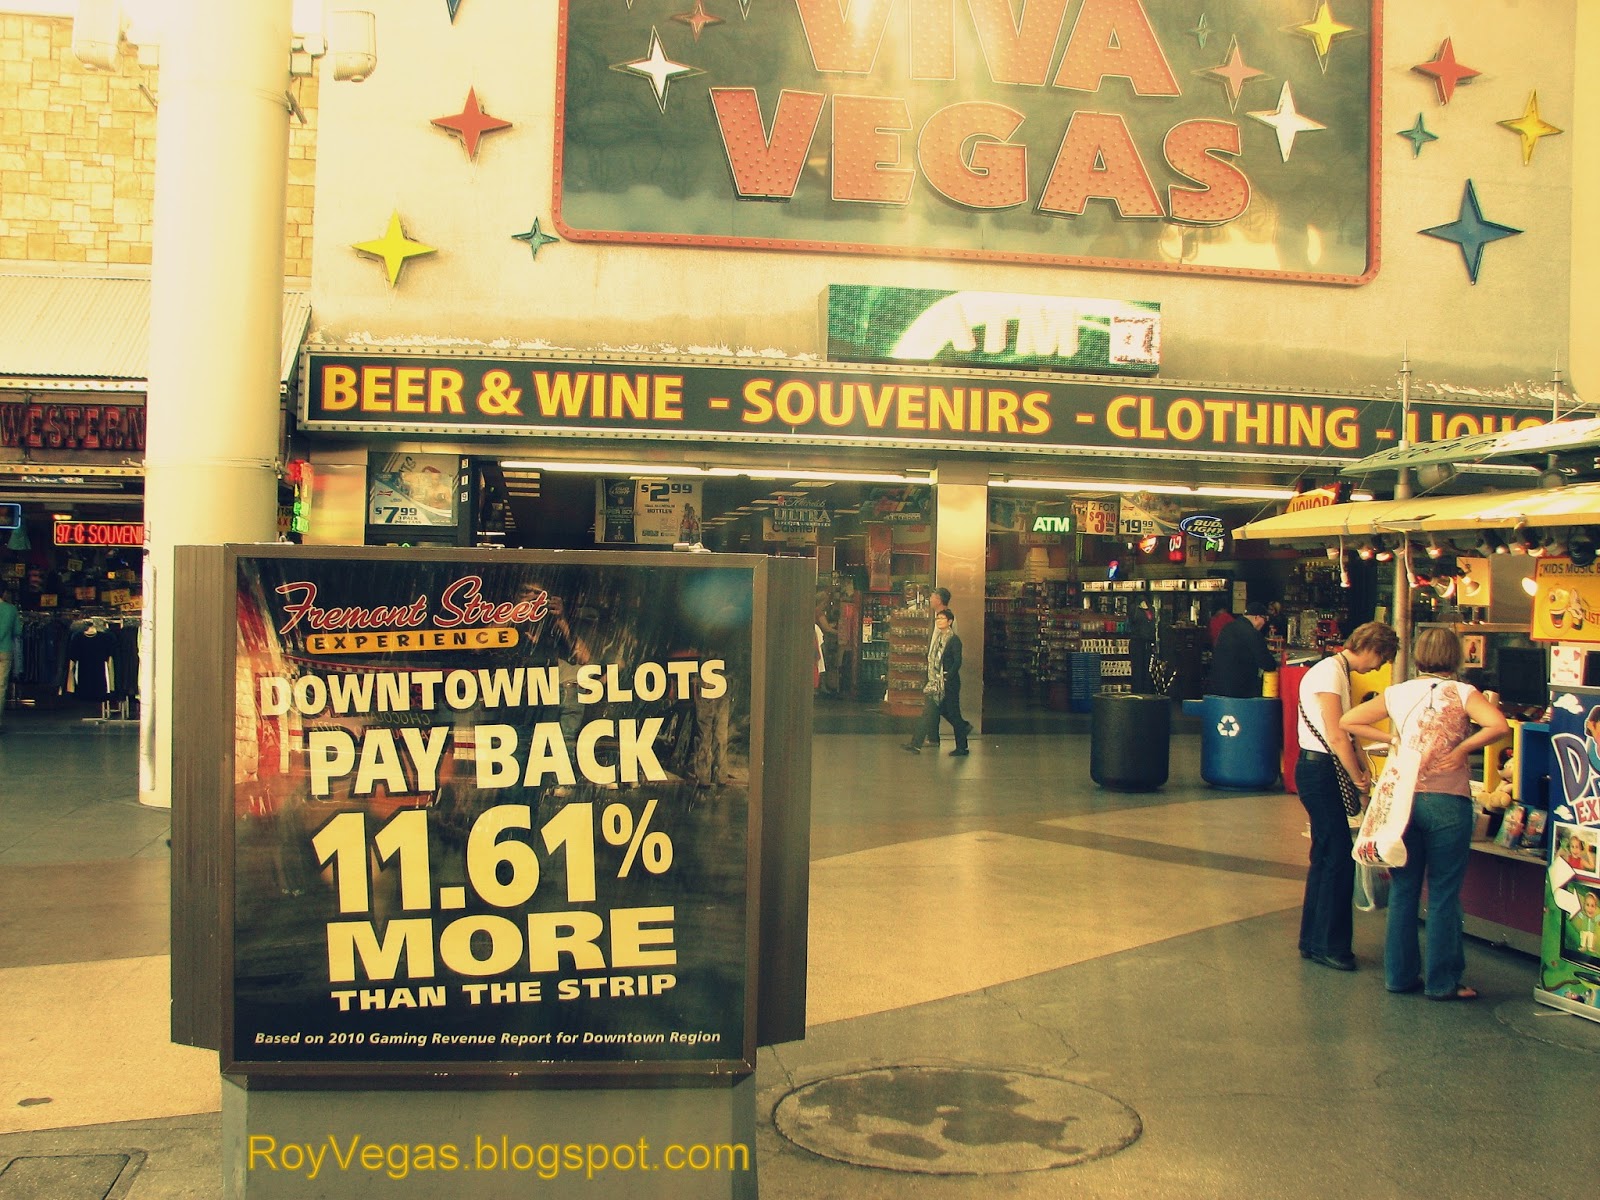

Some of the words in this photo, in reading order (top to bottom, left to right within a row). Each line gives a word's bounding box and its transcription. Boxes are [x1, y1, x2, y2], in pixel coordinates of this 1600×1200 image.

[797, 0, 1182, 97] VIVA
[708, 87, 1252, 225] VEGAS
[935, 300, 1079, 356] ATM
[322, 365, 465, 414] BEER
[477, 369, 523, 416] &
[533, 371, 684, 420] WINE
[742, 378, 1052, 434] SOUVENIRS
[1105, 395, 1360, 449] CLOTHING
[1406, 411, 1577, 444] LIQ
[0, 404, 145, 449] WESTERN
[773, 508, 831, 522] ULTRA
[1032, 516, 1070, 532] ATM
[1099, 502, 1114, 511] FOR
[1193, 519, 1222, 528] BUD
[56, 524, 70, 543] 97
[772, 522, 817, 533] Cashier
[1186, 525, 1225, 533] LIGHT
[1544, 563, 1563, 574] KIDS
[275, 581, 428, 634] Fremont
[433, 575, 548, 628] Street
[314, 630, 510, 650] EXPERIENCE
[259, 666, 560, 716] DOWNTOWN
[576, 660, 728, 704] SLOTS
[309, 724, 450, 796] PAY
[474, 717, 669, 789] BACK
[312, 799, 674, 914] 11.61%
[326, 906, 677, 983] MORE
[330, 985, 446, 1011] THAN
[463, 981, 542, 1005] THE
[558, 974, 677, 1001] STRIP
[255, 1032, 300, 1044] Based
[304, 1034, 324, 1044] on
[328, 1031, 365, 1044] 2010
[369, 1031, 428, 1047] Gaming
[431, 1032, 496, 1044] Revenue
[500, 1032, 552, 1046] Report
[556, 1031, 578, 1043] for
[583, 1031, 665, 1043] Downtown
[669, 1030, 721, 1045] Region
